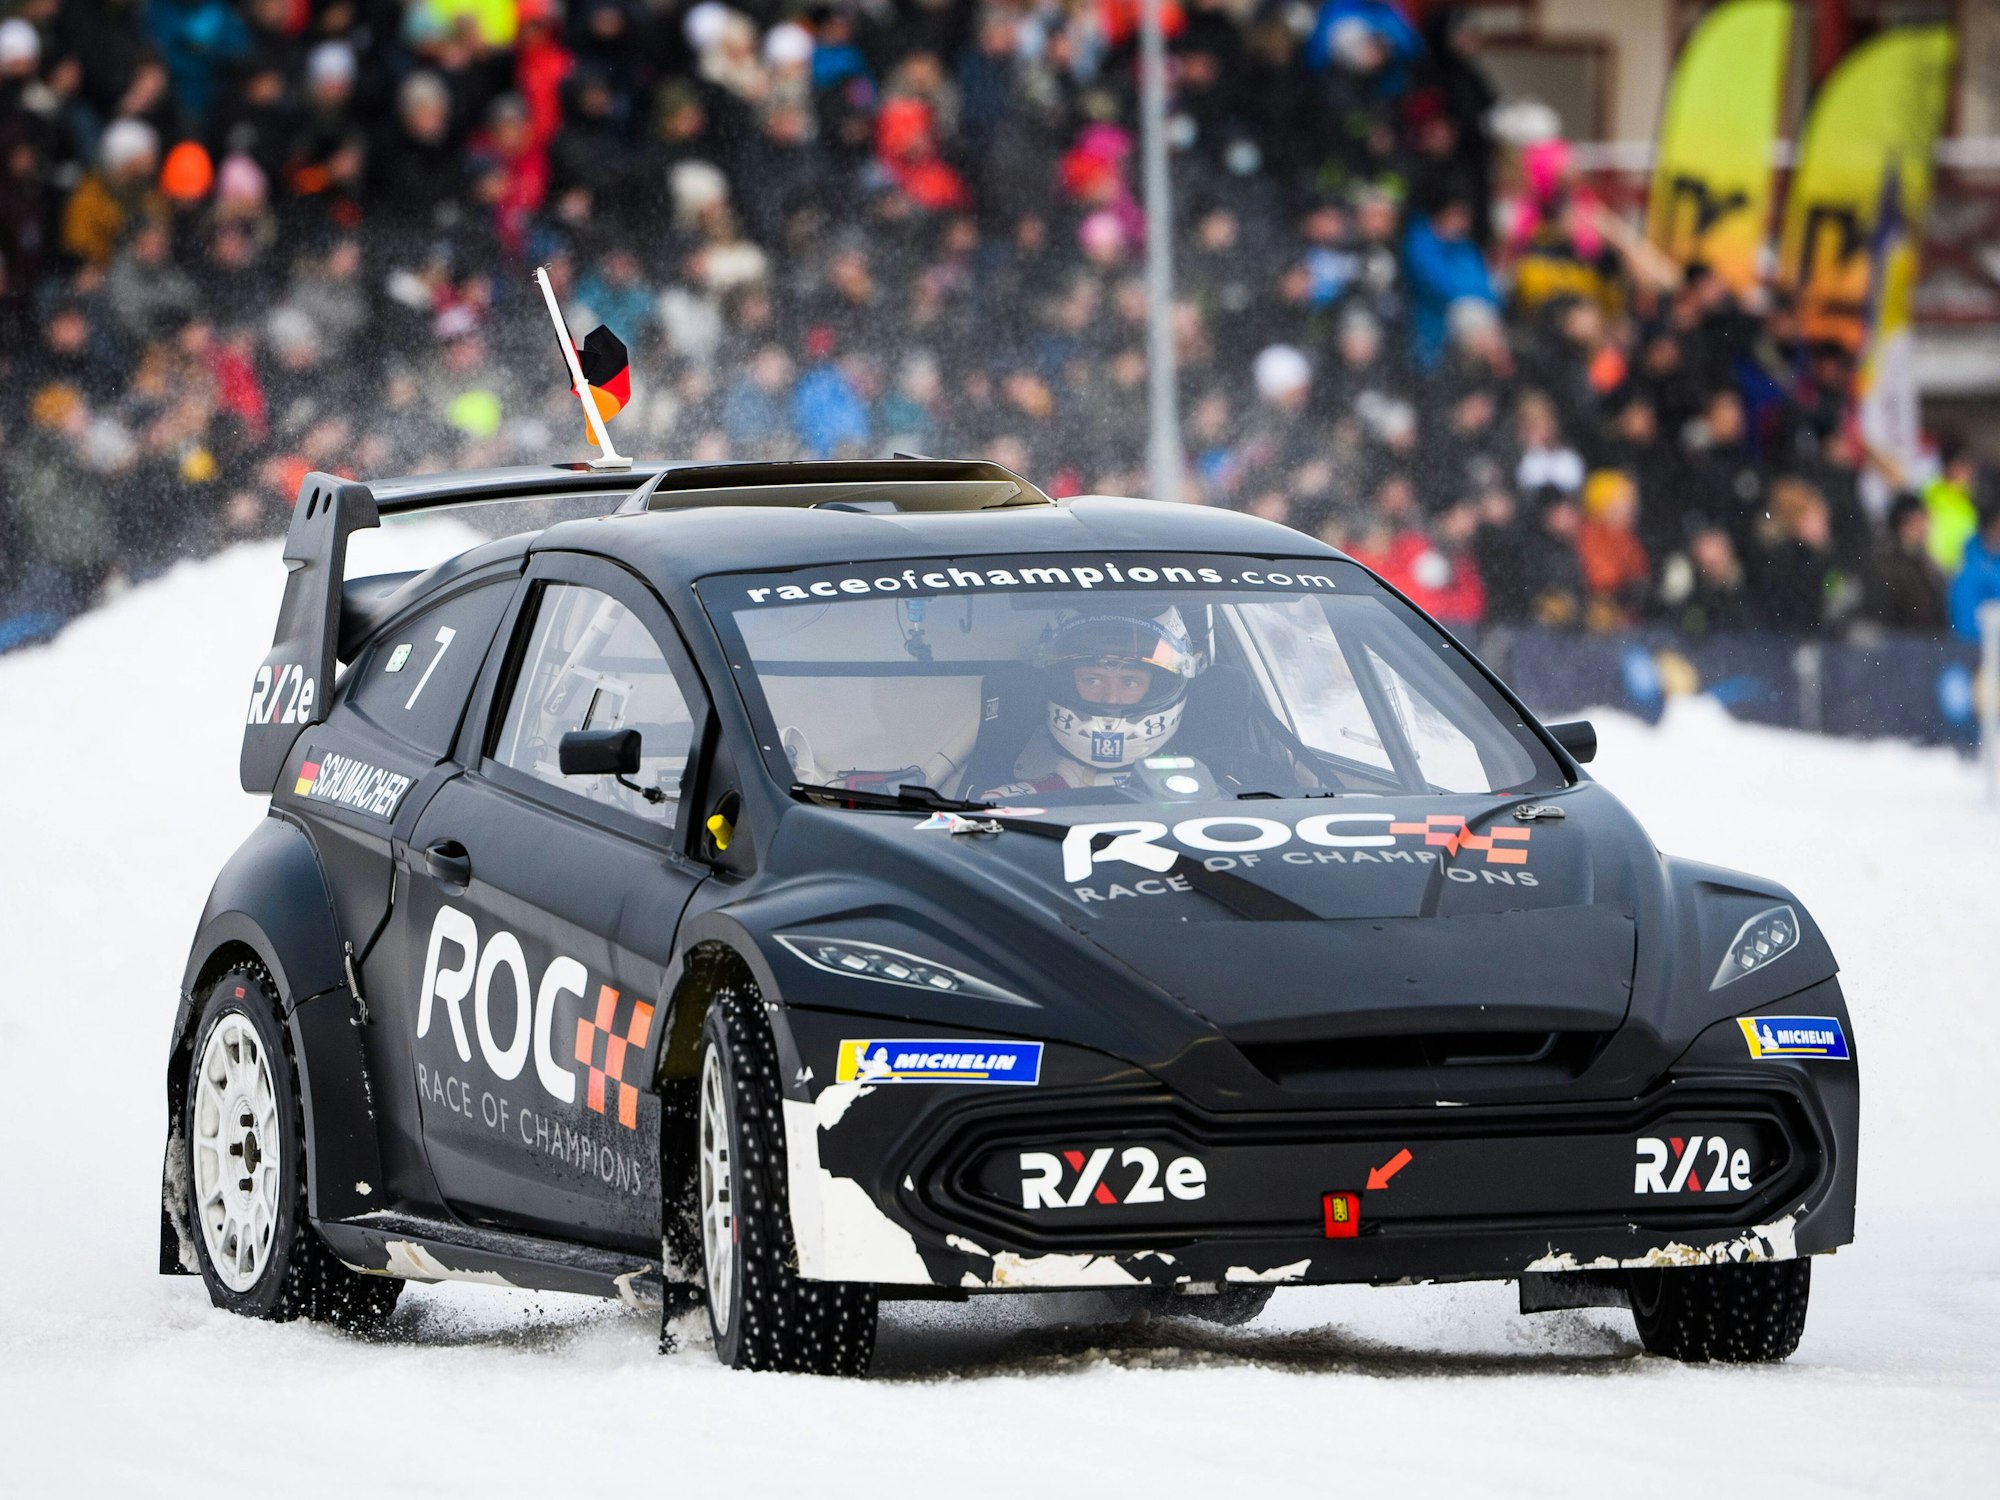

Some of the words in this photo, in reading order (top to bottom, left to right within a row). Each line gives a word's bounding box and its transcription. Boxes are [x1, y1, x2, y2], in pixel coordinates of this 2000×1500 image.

[747, 562, 1336, 603] raceofchampions.com
[1089, 615, 1151, 629] Automation
[247, 663, 315, 725] RX2e
[1093, 738, 1121, 756] 1&1
[311, 751, 410, 818] SCHUMACHER
[1061, 812, 1397, 883] ROC
[1073, 873, 1194, 903] RACE
[1203, 853, 1262, 873] OF
[1281, 850, 1540, 887] CHAMPIONS
[416, 904, 589, 1104] ROC
[893, 1052, 1018, 1071] MICHELIN
[1776, 1029, 1836, 1046] MICHELIN
[418, 1062, 473, 1119] RACE
[481, 1091, 510, 1133] OF
[519, 1107, 642, 1197] CHAMPIONS
[1019, 1146, 1208, 1210] RX2e
[1633, 1135, 1753, 1194] RX2e
